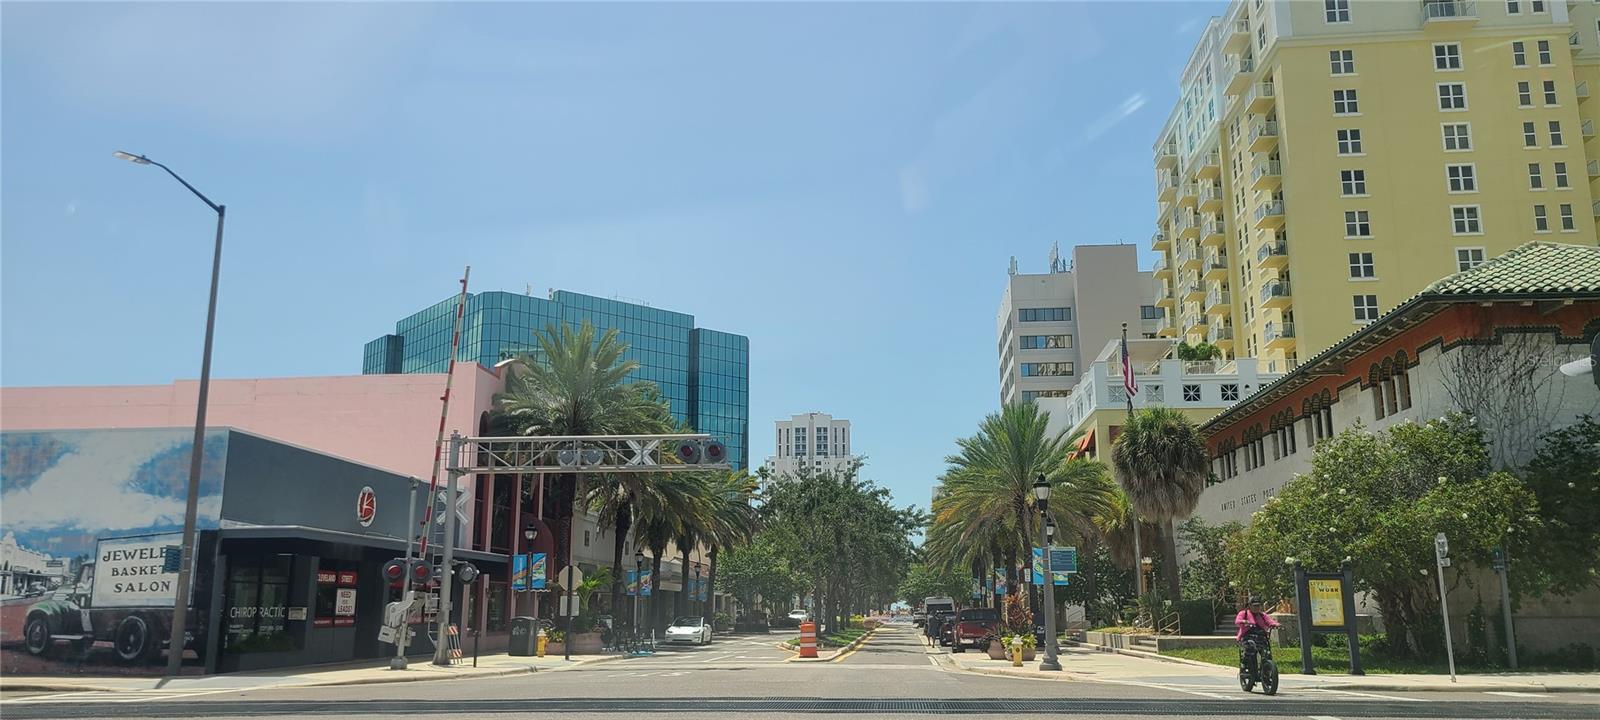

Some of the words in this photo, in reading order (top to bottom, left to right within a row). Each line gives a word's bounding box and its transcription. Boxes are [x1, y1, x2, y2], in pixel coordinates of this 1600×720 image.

[1241, 493, 1257, 506] STATES
[1262, 487, 1275, 500] POST
[113, 580, 172, 593] SALON
